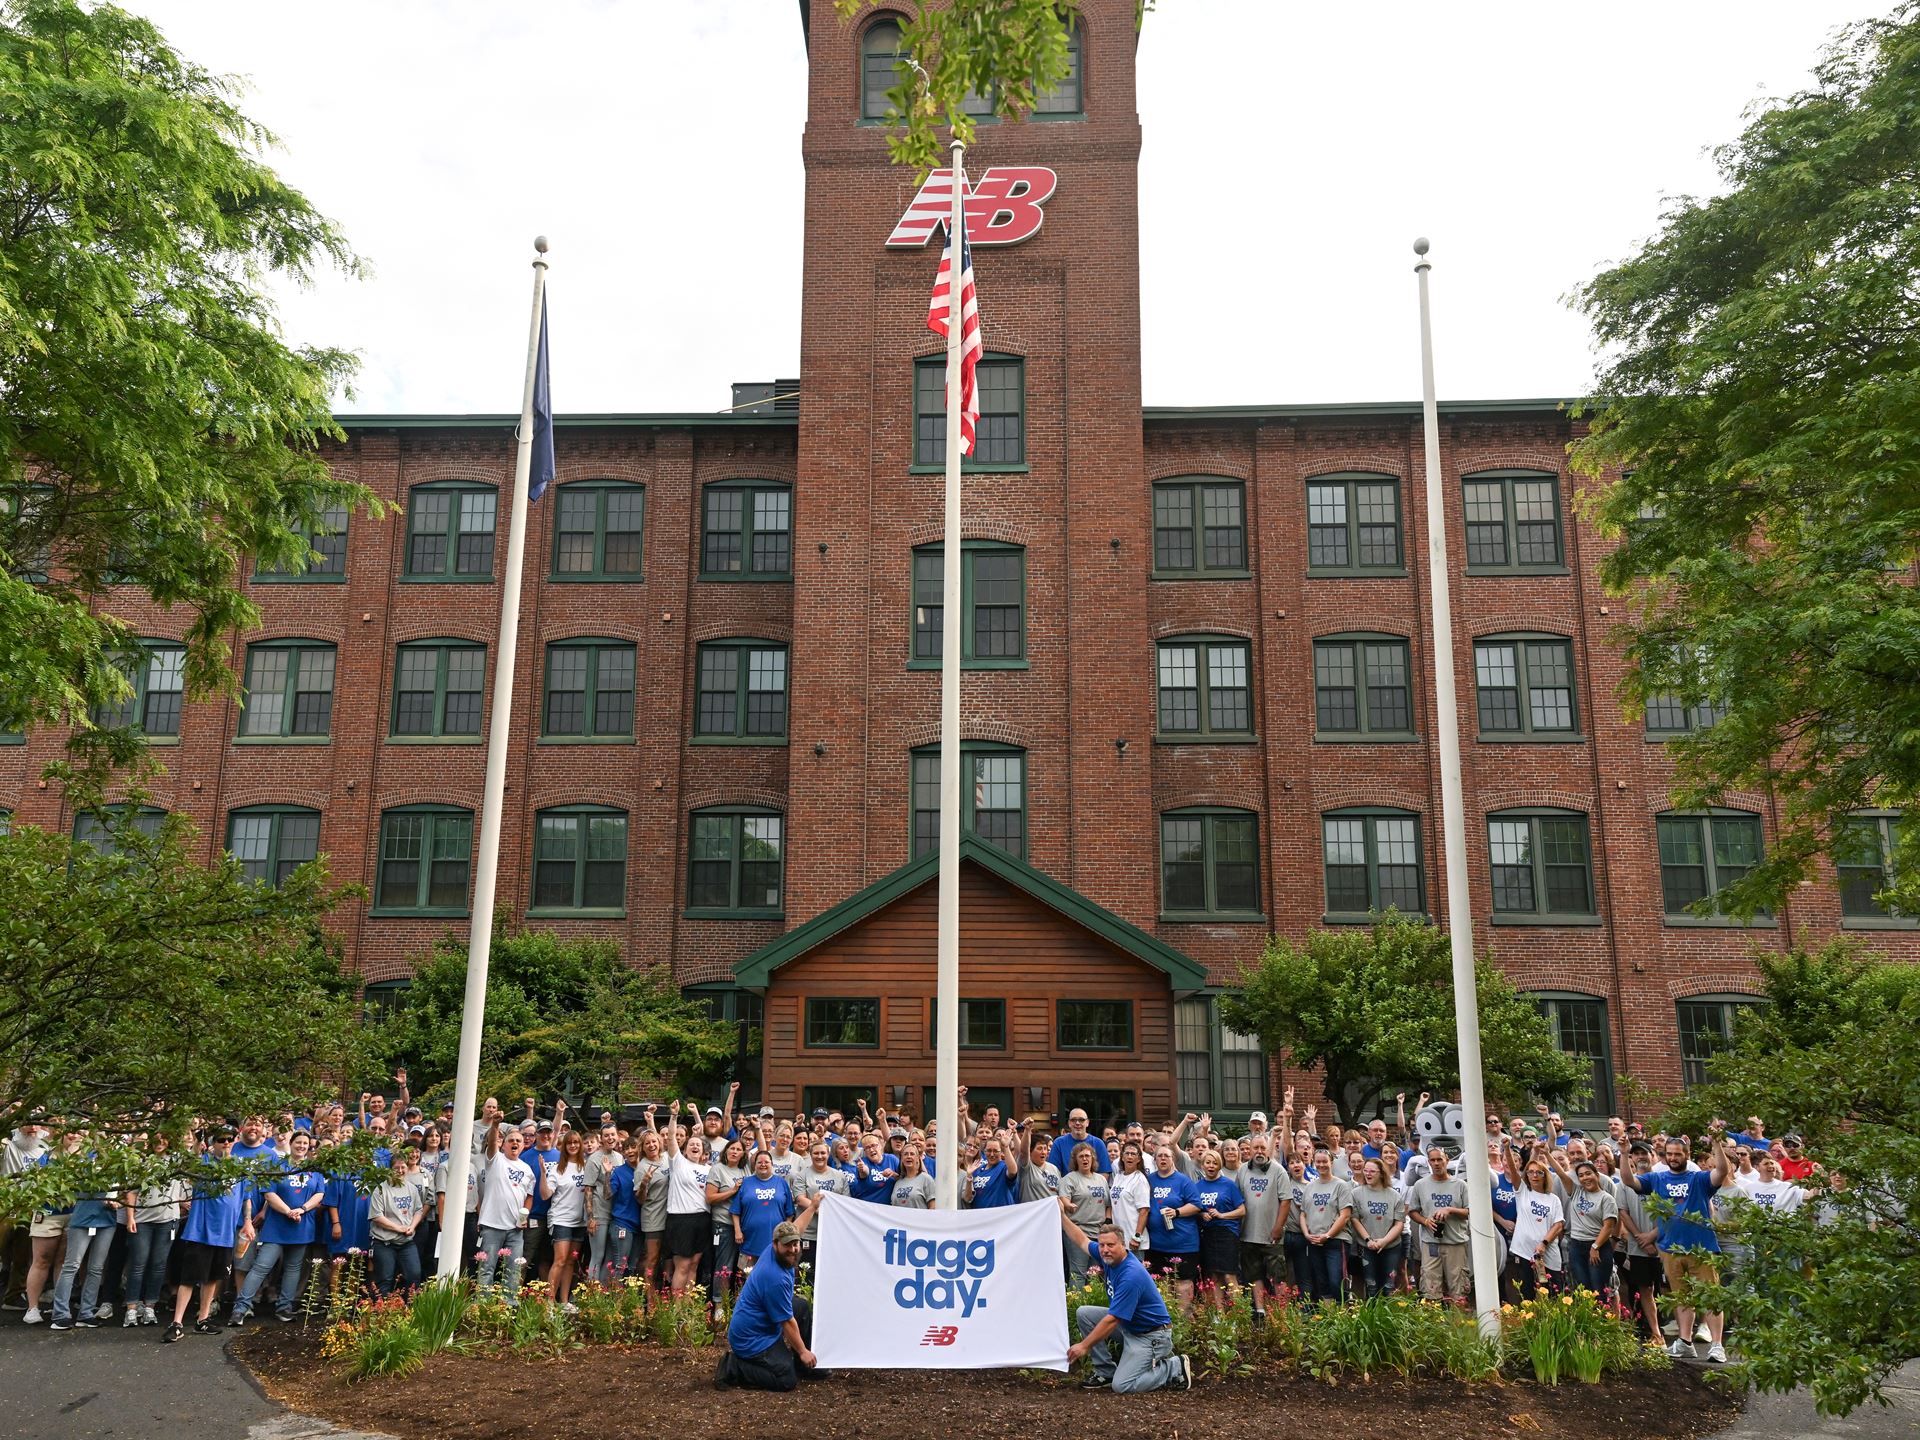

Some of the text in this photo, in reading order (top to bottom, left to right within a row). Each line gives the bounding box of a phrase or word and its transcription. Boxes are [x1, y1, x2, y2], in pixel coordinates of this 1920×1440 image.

[885, 167, 1057, 249] NB
[1249, 1177, 1269, 1186] flagg
[1251, 1184, 1267, 1192] day.
[1666, 1183, 1689, 1192] flagg
[757, 1192, 774, 1200] day.
[1313, 1193, 1331, 1201] flagg
[1431, 1193, 1453, 1202] flagg
[1669, 1189, 1689, 1198] day.
[1755, 1192, 1777, 1200] flagg
[1314, 1199, 1328, 1207] day.
[1368, 1200, 1389, 1209] flagg
[1530, 1200, 1551, 1212] flagg
[1369, 1207, 1387, 1216] day.
[1532, 1208, 1548, 1219] day.
[882, 1228, 996, 1279] flagg
[893, 1269, 987, 1318] day.
[919, 1325, 959, 1346] NB
